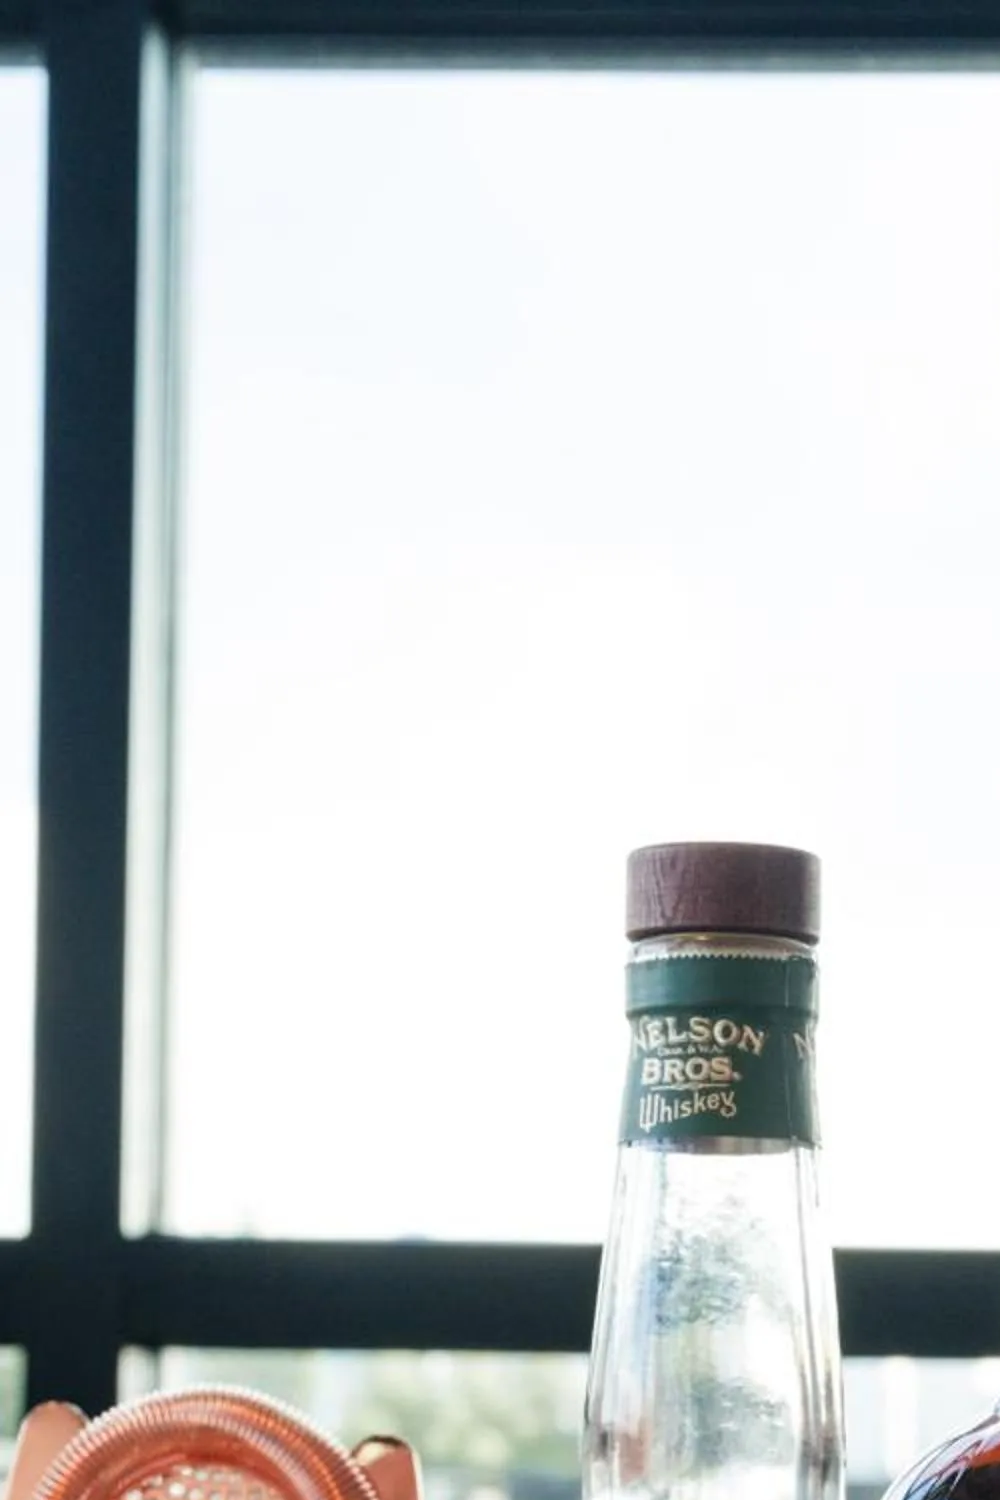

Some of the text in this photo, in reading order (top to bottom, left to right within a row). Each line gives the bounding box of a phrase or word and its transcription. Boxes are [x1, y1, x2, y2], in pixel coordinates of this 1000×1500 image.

[632, 1014, 768, 1059] NELSON
[641, 1056, 744, 1086] BROS.
[639, 1089, 738, 1133] Whiskey
